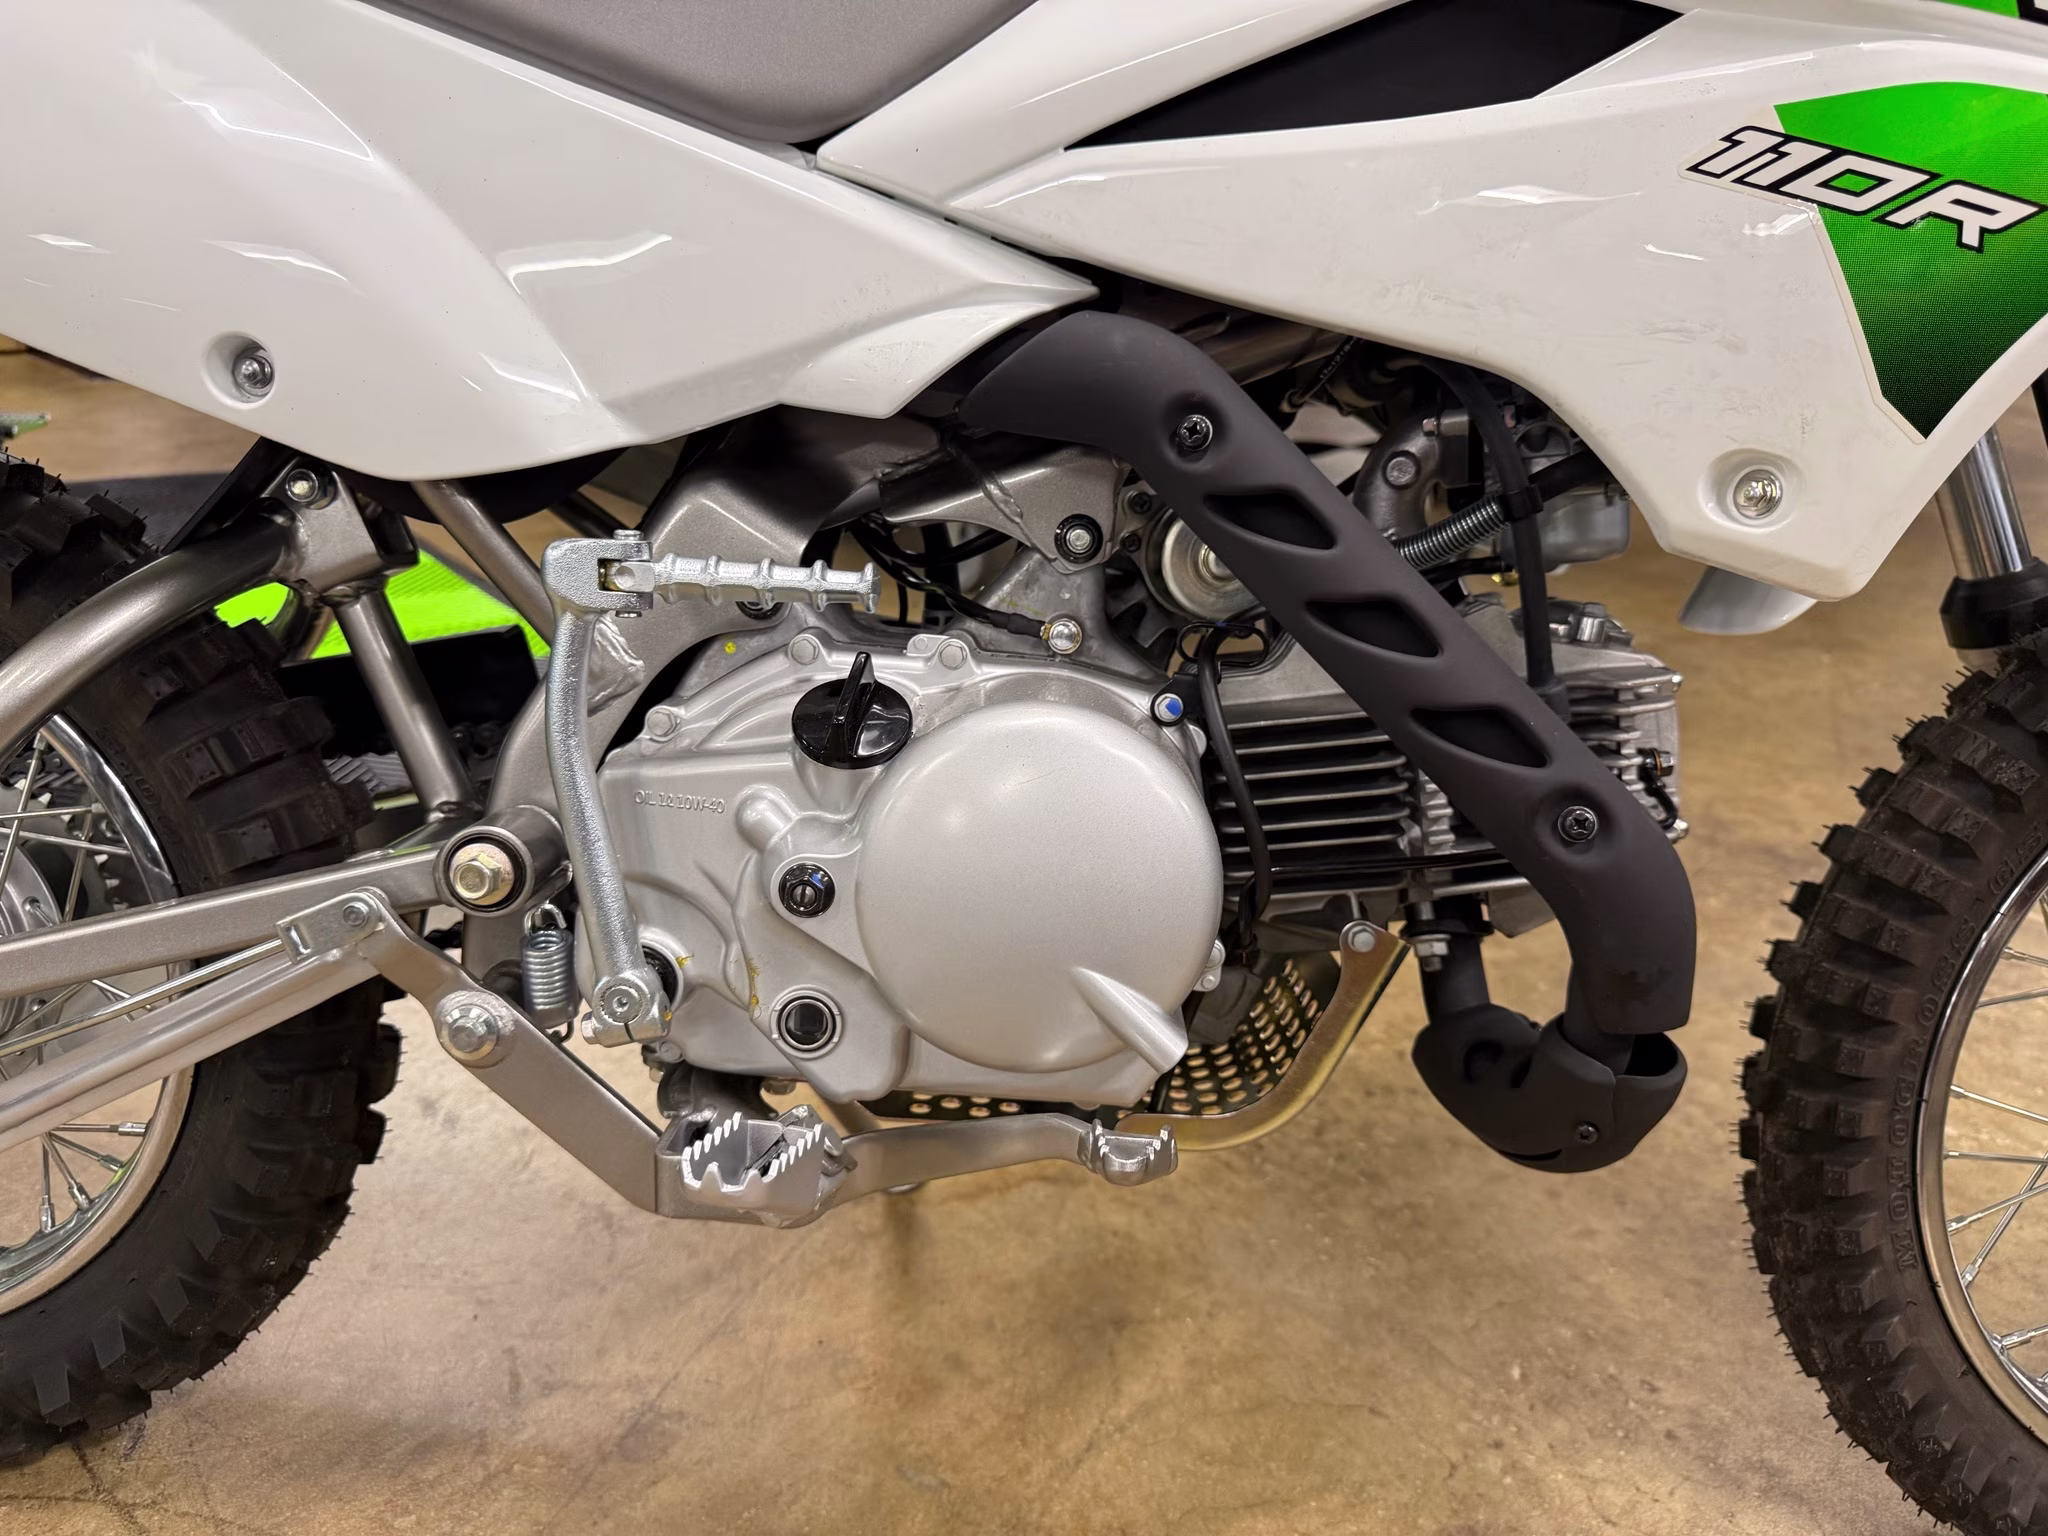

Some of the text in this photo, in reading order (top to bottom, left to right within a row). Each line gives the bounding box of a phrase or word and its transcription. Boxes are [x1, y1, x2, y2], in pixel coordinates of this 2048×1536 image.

[1685, 125, 2047, 254] 110R
[635, 789, 656, 805] OIL
[676, 793, 726, 813] 10W-40
[1889, 920, 1976, 1271] MOTOCROSS
